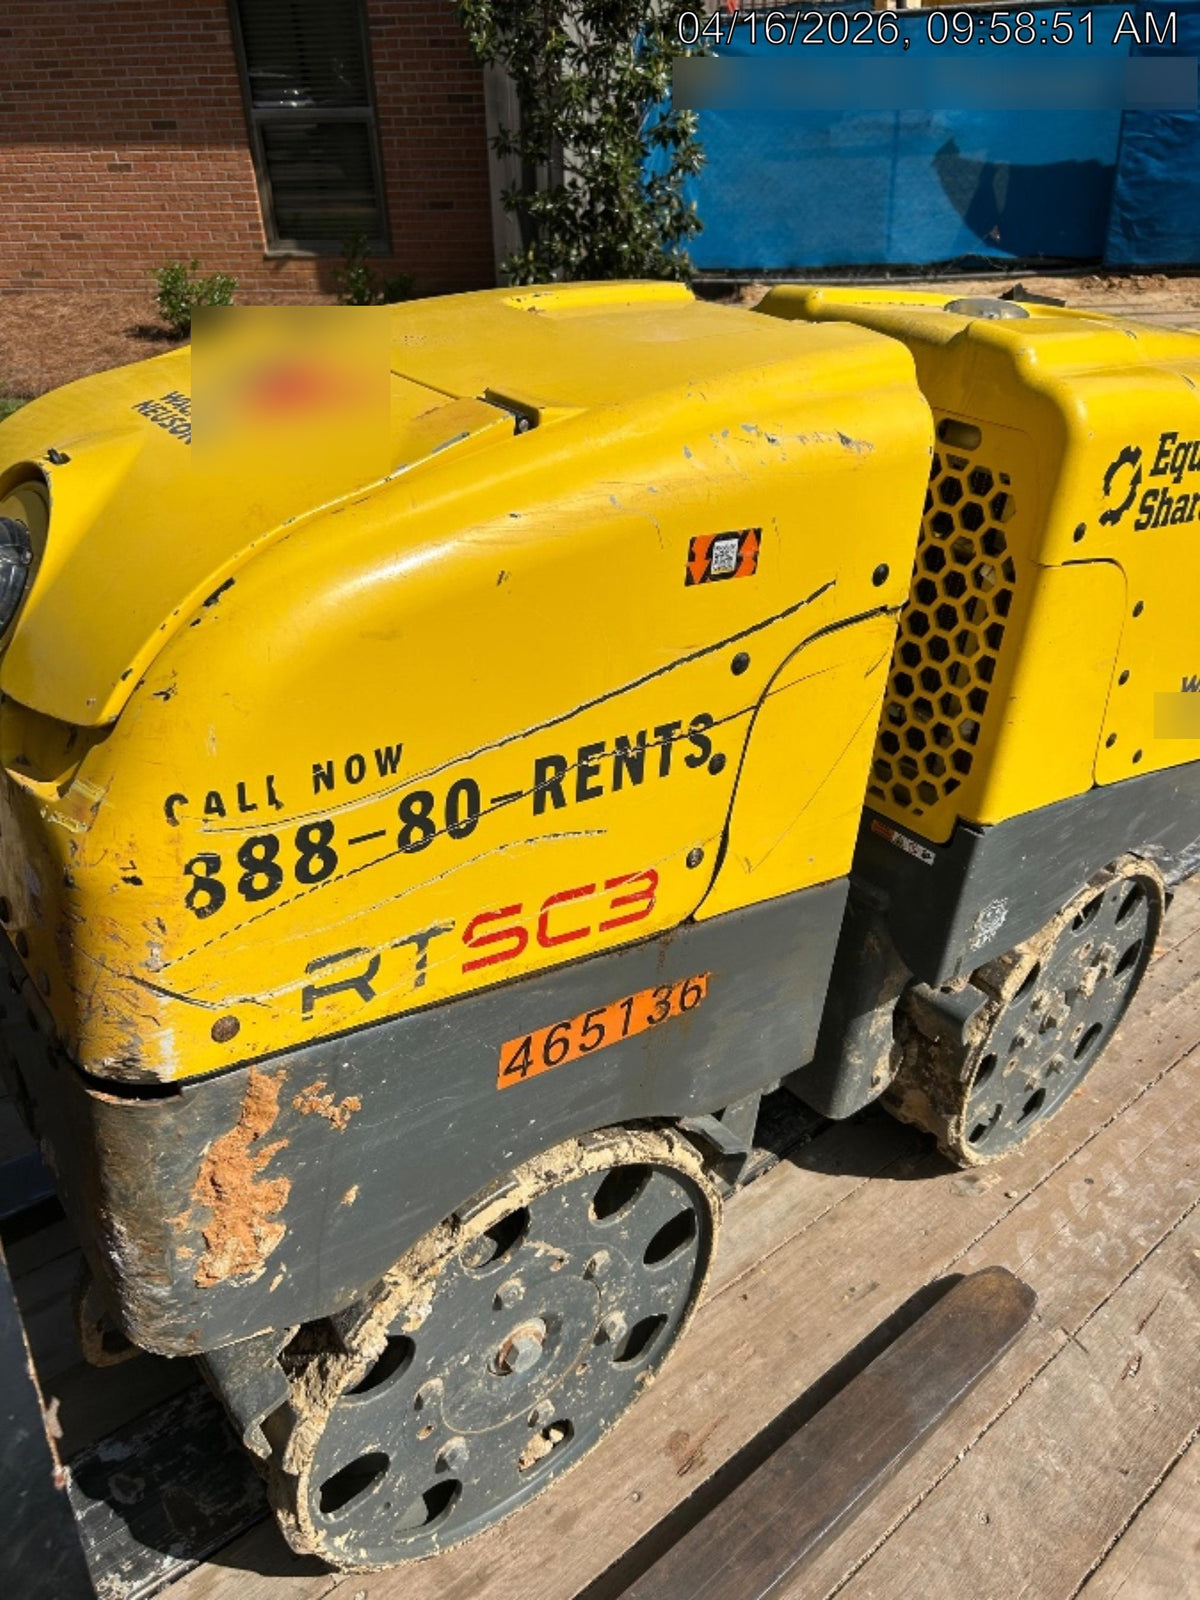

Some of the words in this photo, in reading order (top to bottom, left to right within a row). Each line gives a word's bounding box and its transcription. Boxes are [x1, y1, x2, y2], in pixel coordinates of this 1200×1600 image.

[1134, 486, 1200, 532] Shar
[164, 774, 284, 827] CALL
[312, 743, 403, 795] NOW
[183, 712, 714, 919] 888-80-RENTS
[502, 974, 704, 1078] 465136
